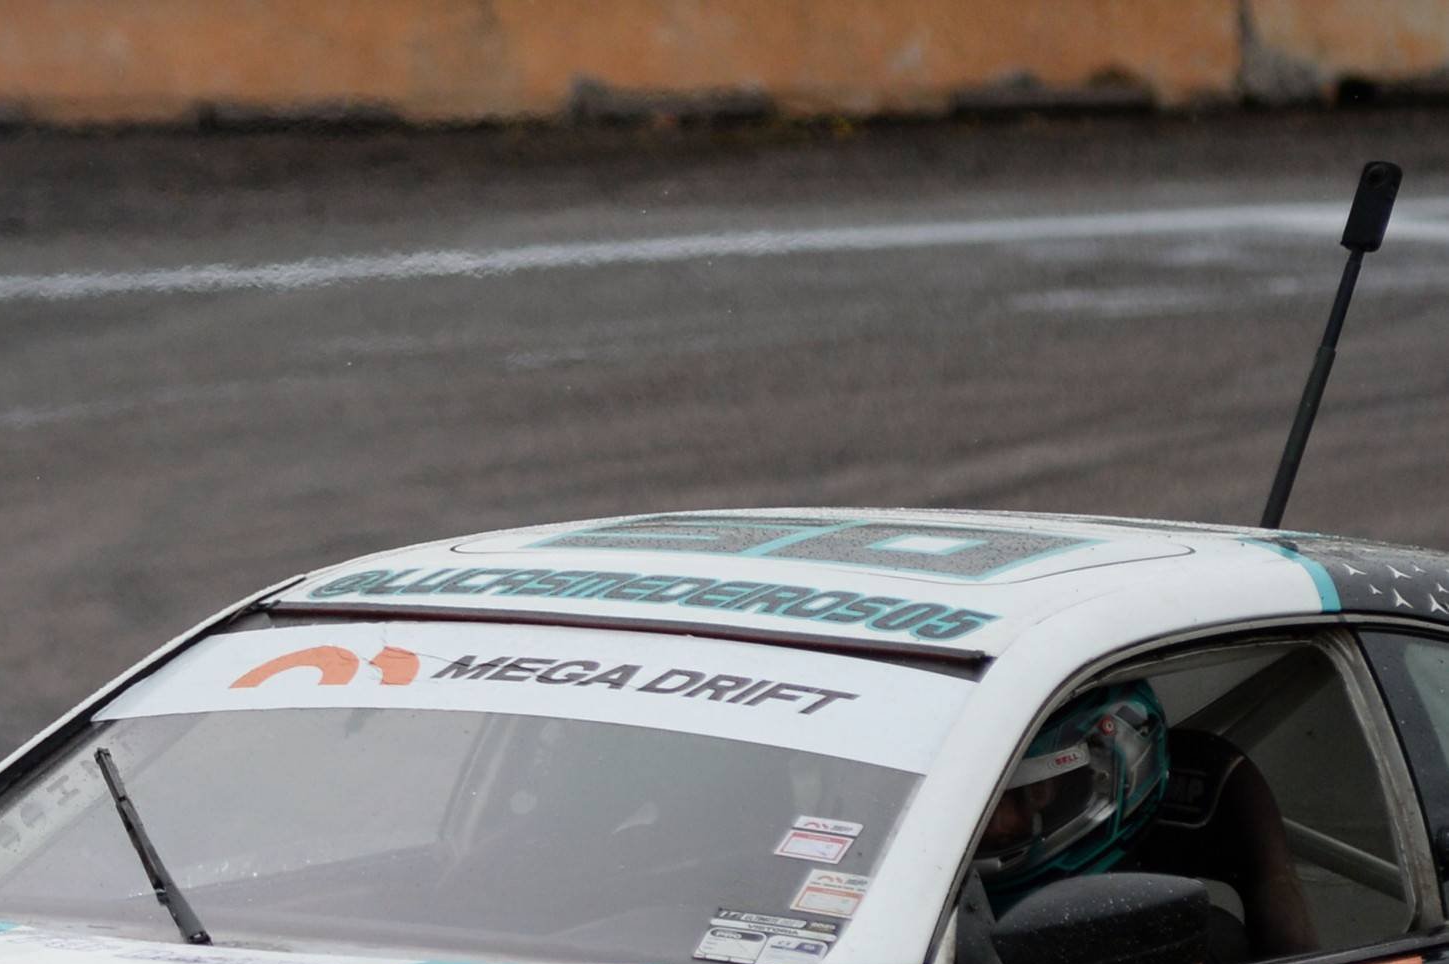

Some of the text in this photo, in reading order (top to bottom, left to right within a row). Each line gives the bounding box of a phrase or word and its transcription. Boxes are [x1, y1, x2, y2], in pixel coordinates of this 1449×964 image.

[307, 567, 1000, 642] @LUCASMEDEIROS05
[430, 655, 860, 715] MEGA DRIFT
[1055, 754, 1079, 766] BELL
